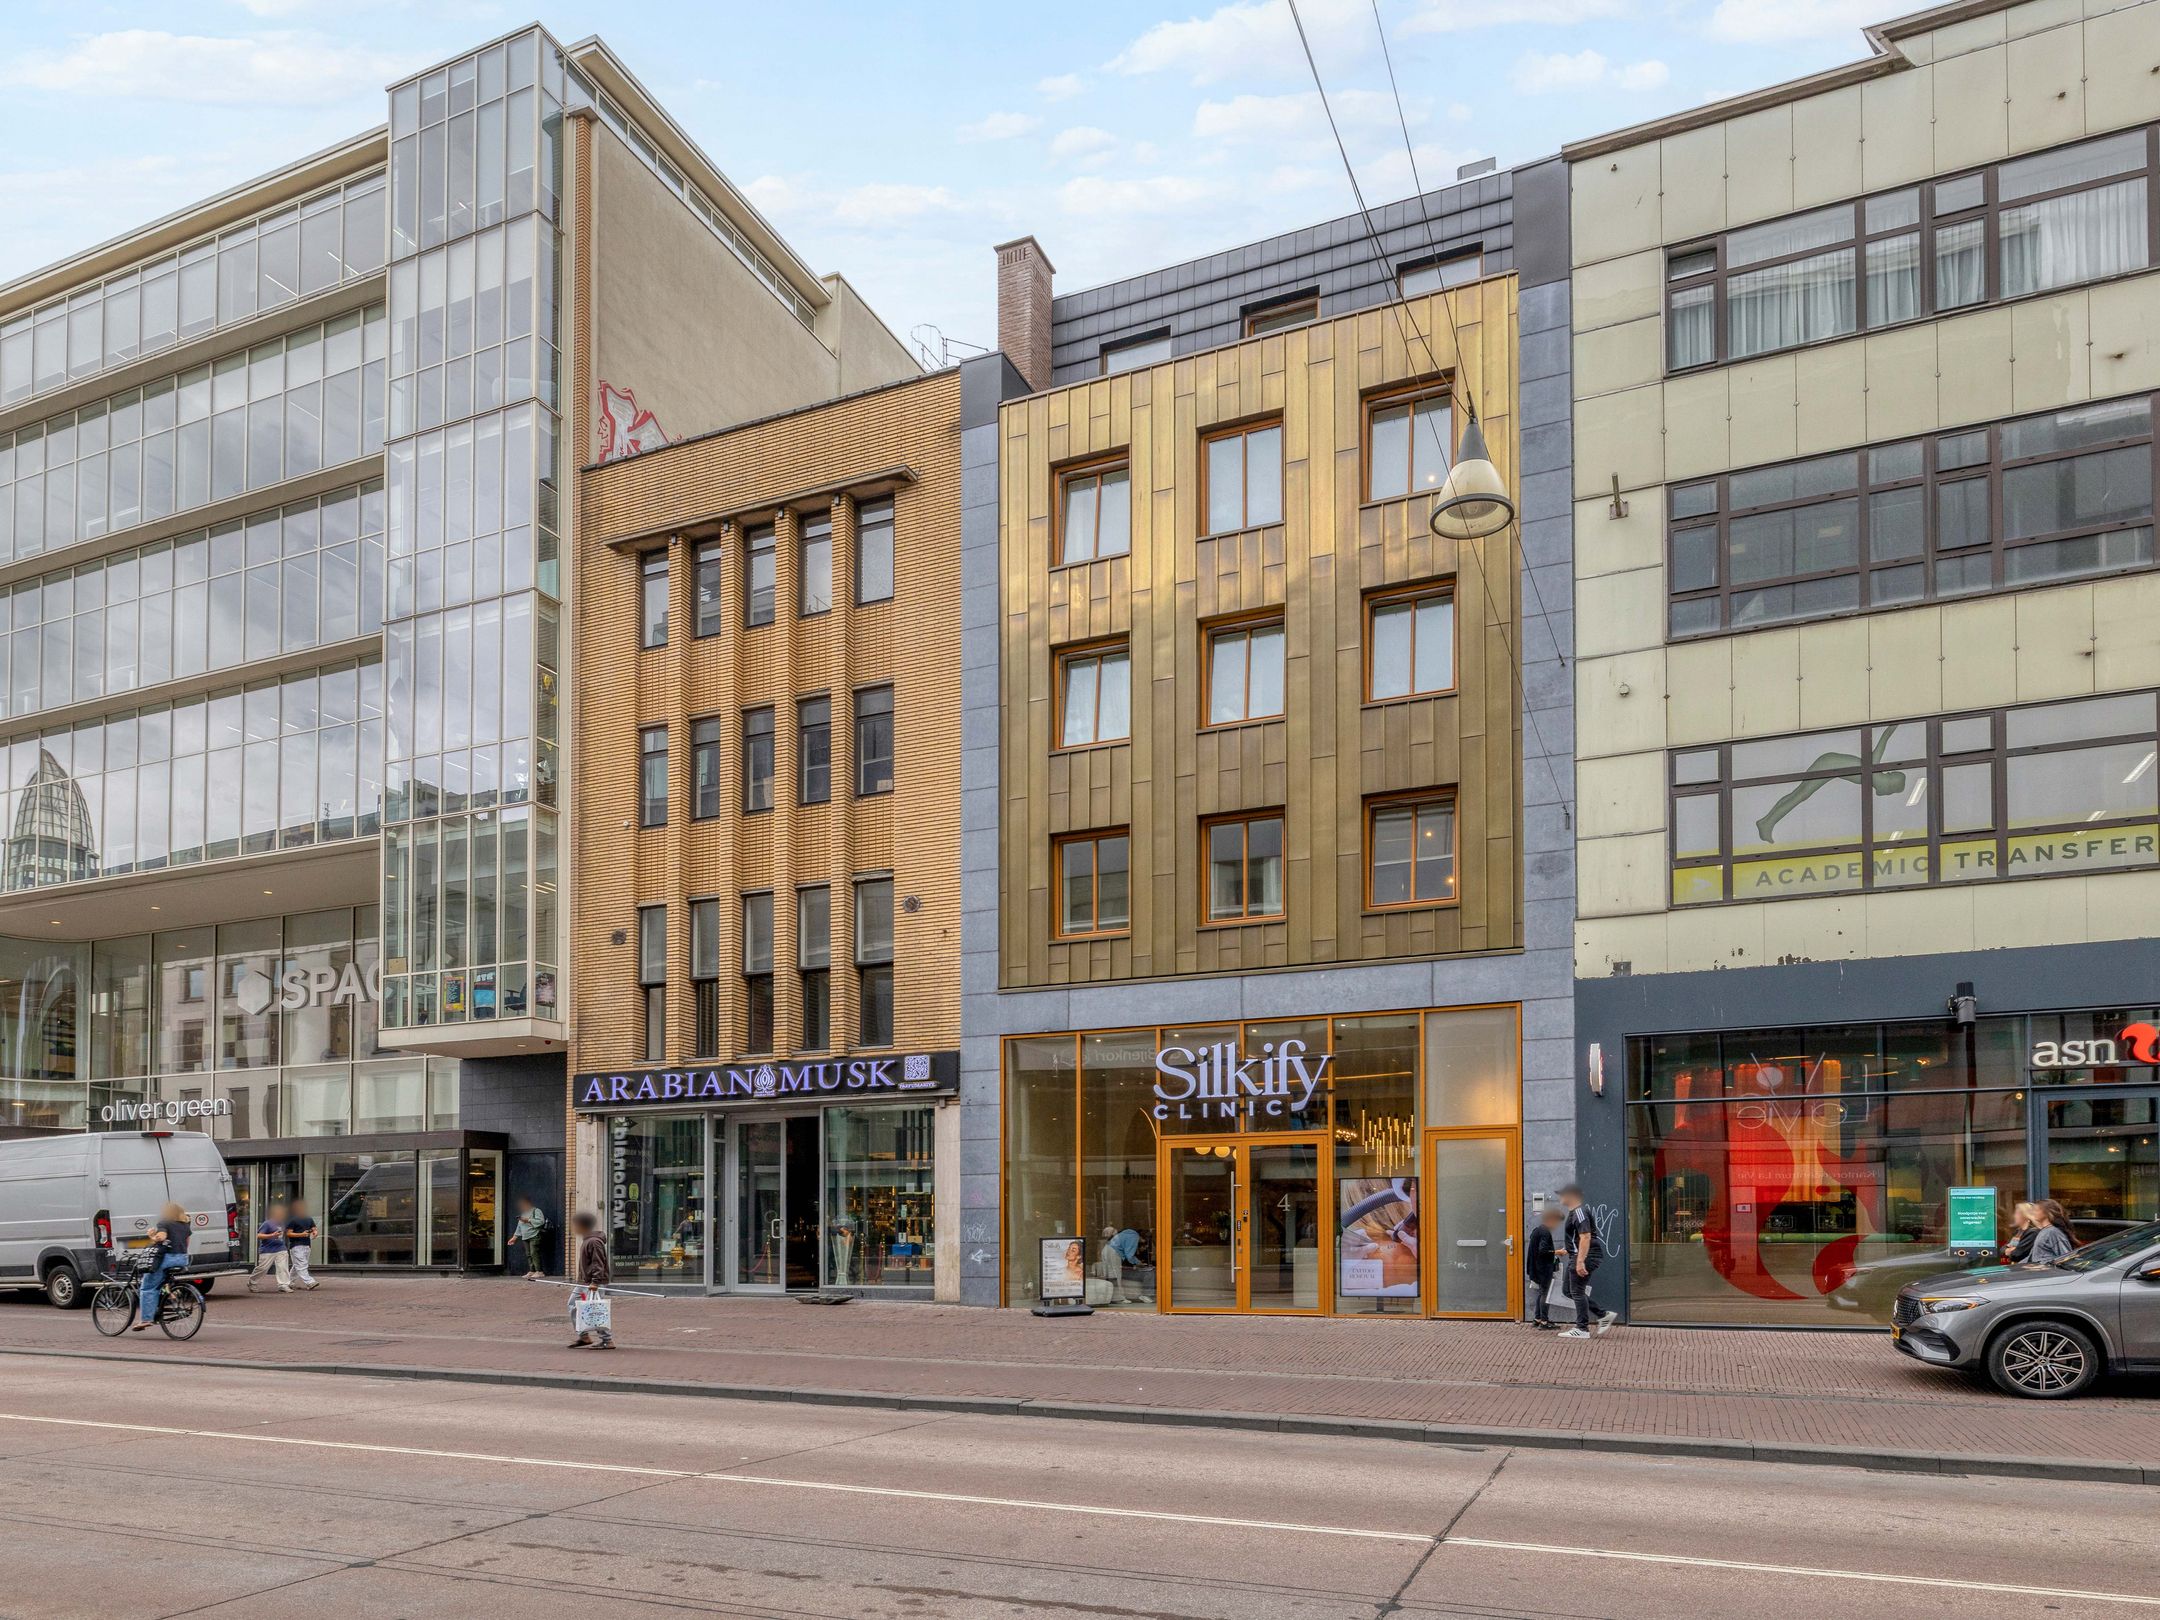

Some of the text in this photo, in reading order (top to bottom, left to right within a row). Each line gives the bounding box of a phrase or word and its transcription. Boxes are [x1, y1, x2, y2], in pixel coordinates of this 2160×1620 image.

[1755, 836, 2155, 887] ACADEMIC TRANSFER
[2031, 1037, 2119, 1067] asn
[582, 1060, 896, 1102] ARABIAN MUSK
[1154, 1039, 1334, 1112] Silkify
[101, 1096, 227, 1125] oliver green
[1154, 1100, 1282, 1120] CLINIC
[1277, 1193, 1291, 1212] 4
